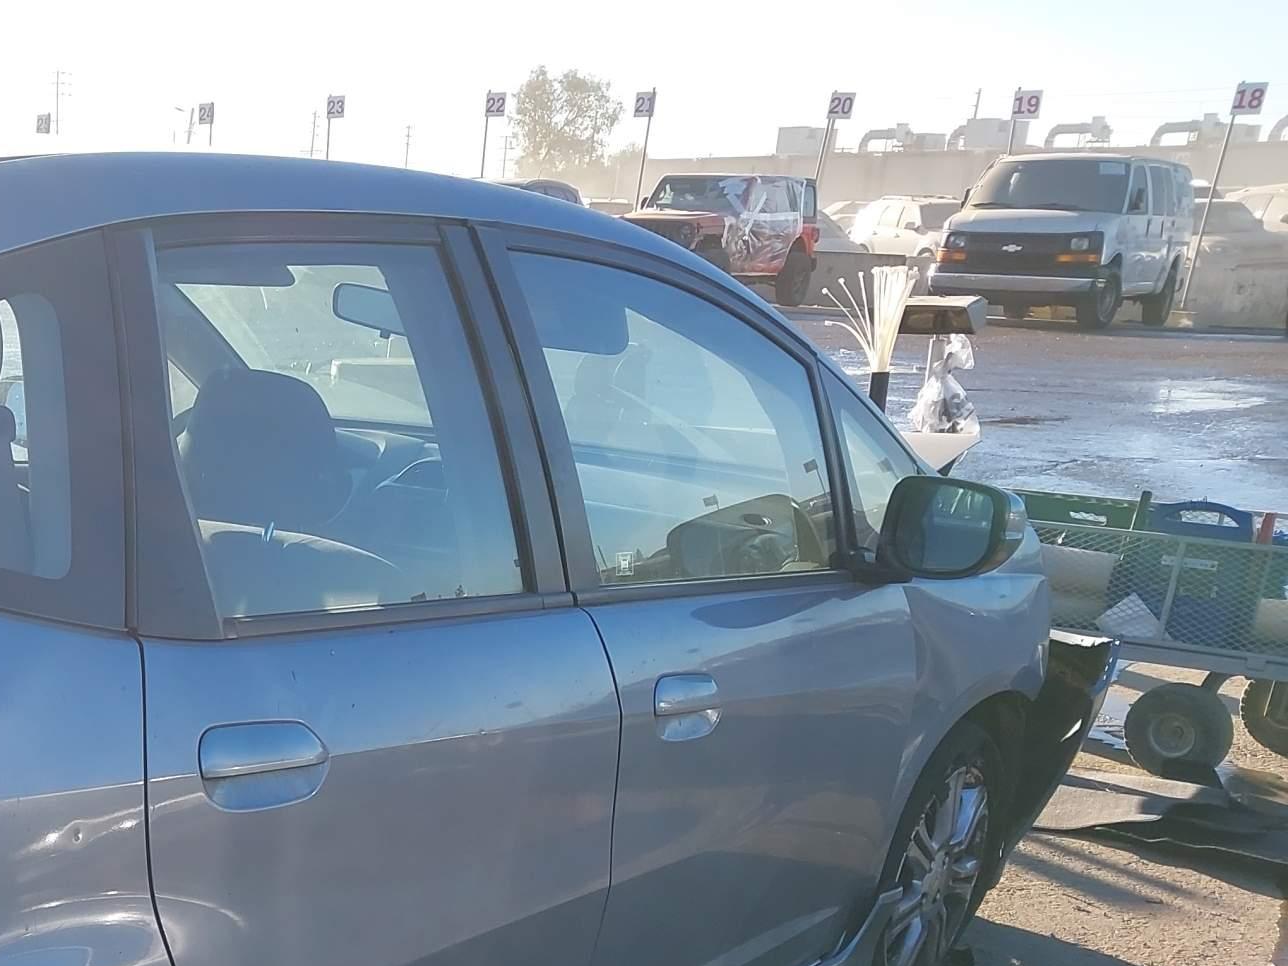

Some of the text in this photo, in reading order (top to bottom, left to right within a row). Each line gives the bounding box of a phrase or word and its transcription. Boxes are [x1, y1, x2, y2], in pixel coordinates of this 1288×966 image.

[487, 97, 505, 113] 22
[829, 97, 853, 114] 20
[1013, 96, 1040, 114] 19
[1232, 89, 1264, 109] 18
[328, 101, 344, 115] 23
